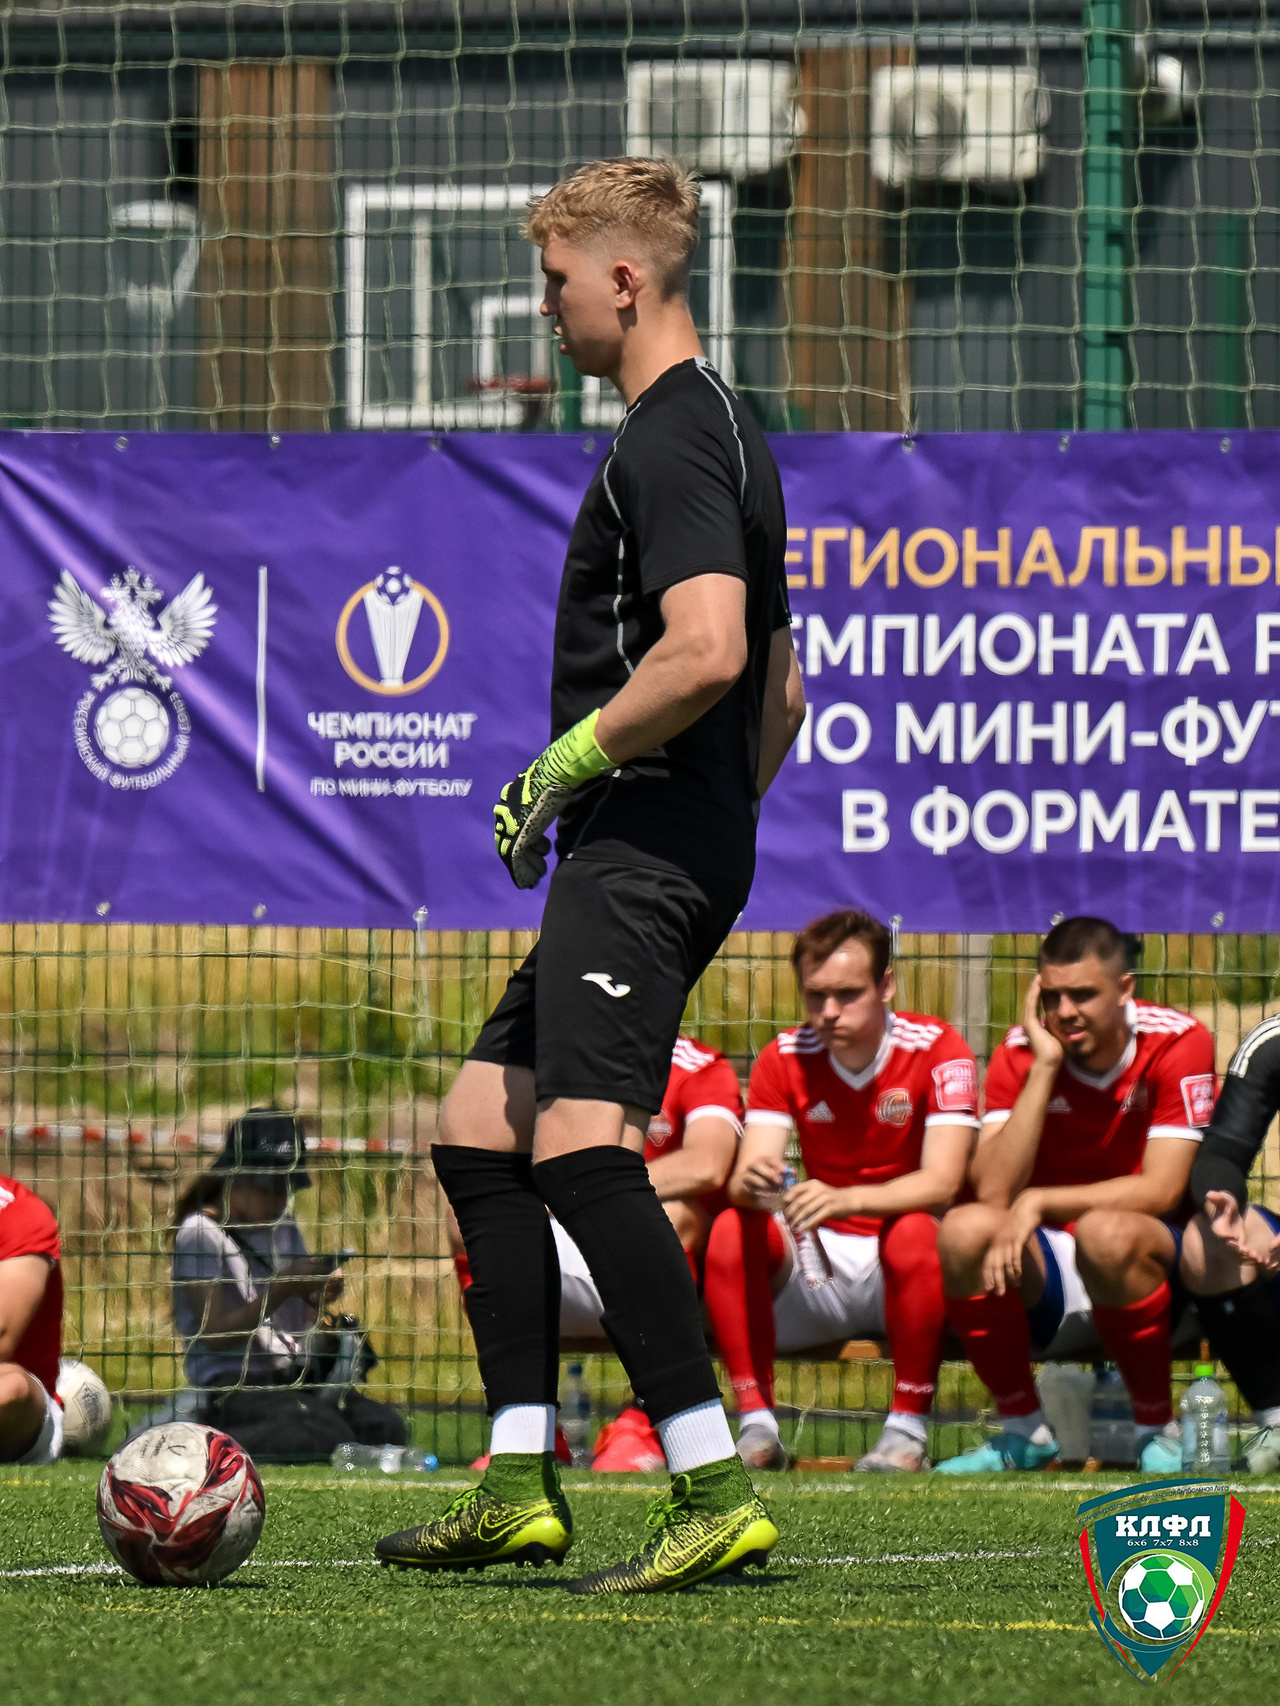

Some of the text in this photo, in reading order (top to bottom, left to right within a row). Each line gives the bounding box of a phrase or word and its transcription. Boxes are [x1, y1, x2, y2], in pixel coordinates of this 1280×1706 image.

[307, 711, 478, 740] ЧЕМПИОНАТ
[894, 697, 1280, 766] МИНИ-ФУ
[333, 741, 450, 769] РОССИИ
[309, 776, 473, 798] ПО МИНИ-ФУТБОЛУ
[841, 785, 1280, 854] В ФОРМАТЕ
